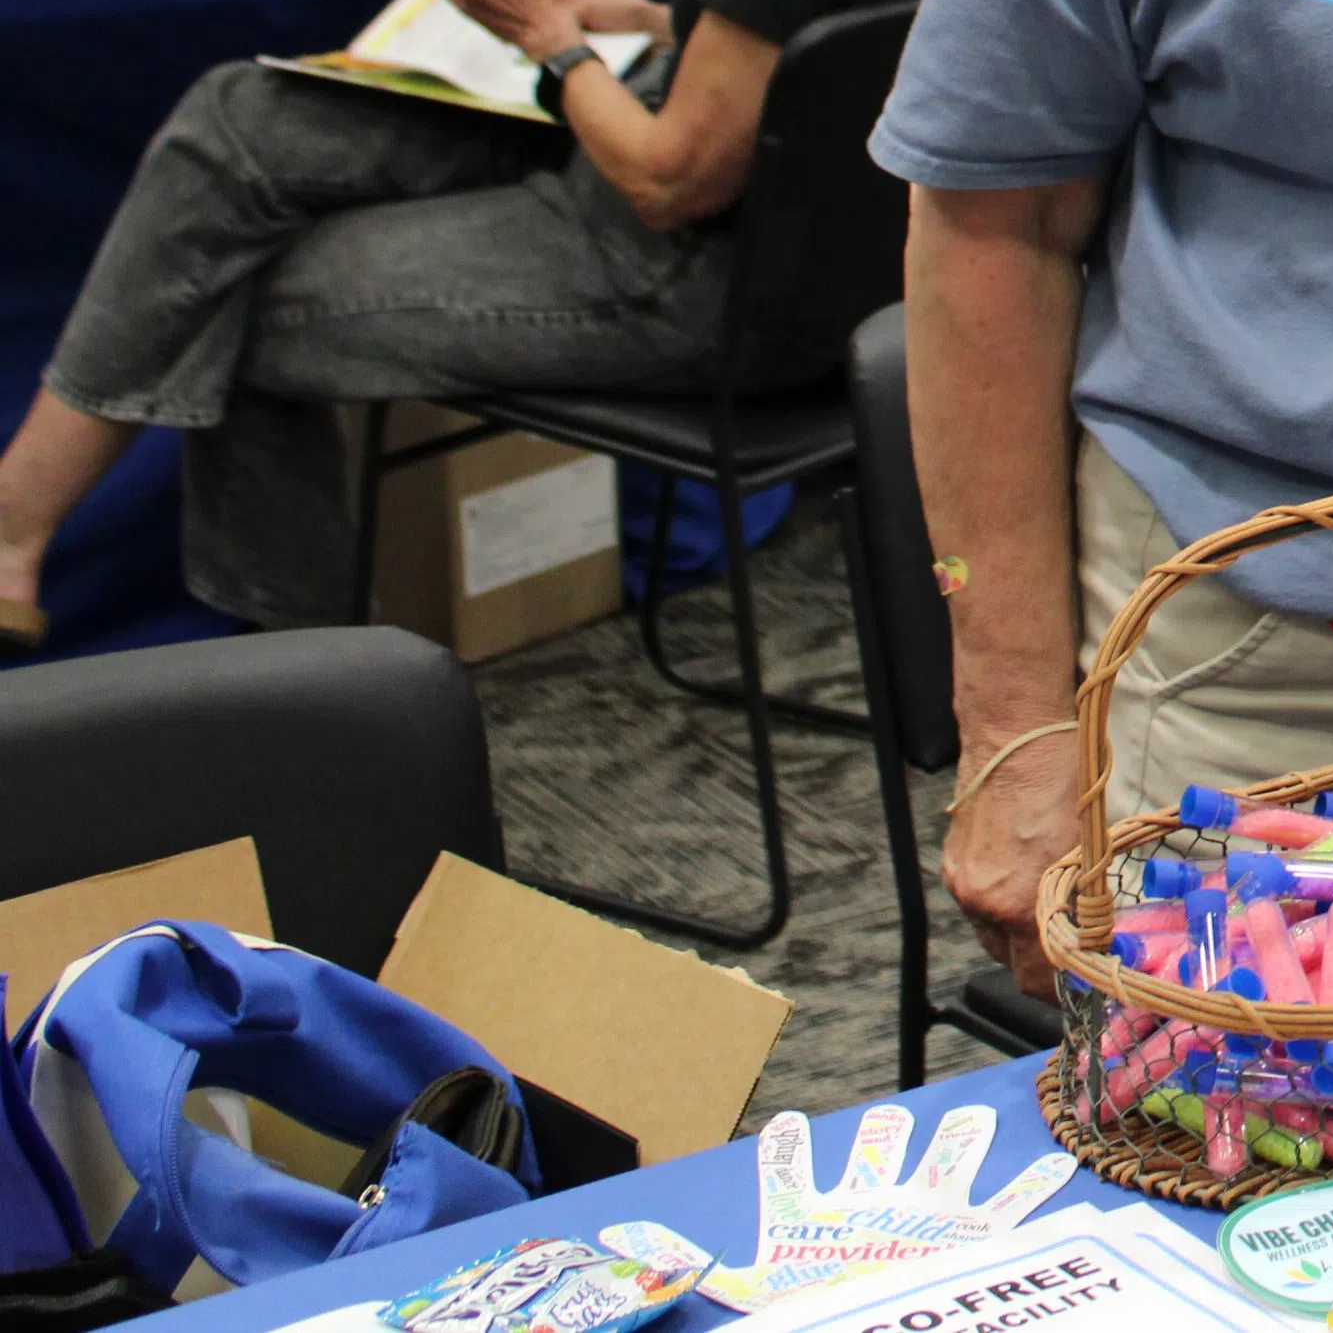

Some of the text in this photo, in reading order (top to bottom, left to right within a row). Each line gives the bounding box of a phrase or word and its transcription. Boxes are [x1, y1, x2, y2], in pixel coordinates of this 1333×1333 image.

[767, 1223, 856, 1242] care
[847, 1207, 958, 1243] child
[769, 1240, 942, 1265] provider
[1237, 1224, 1301, 1254] VIBE
[1265, 1239, 1330, 1264] WELLNESS
[955, 1277, 1123, 1333] ACILITY
